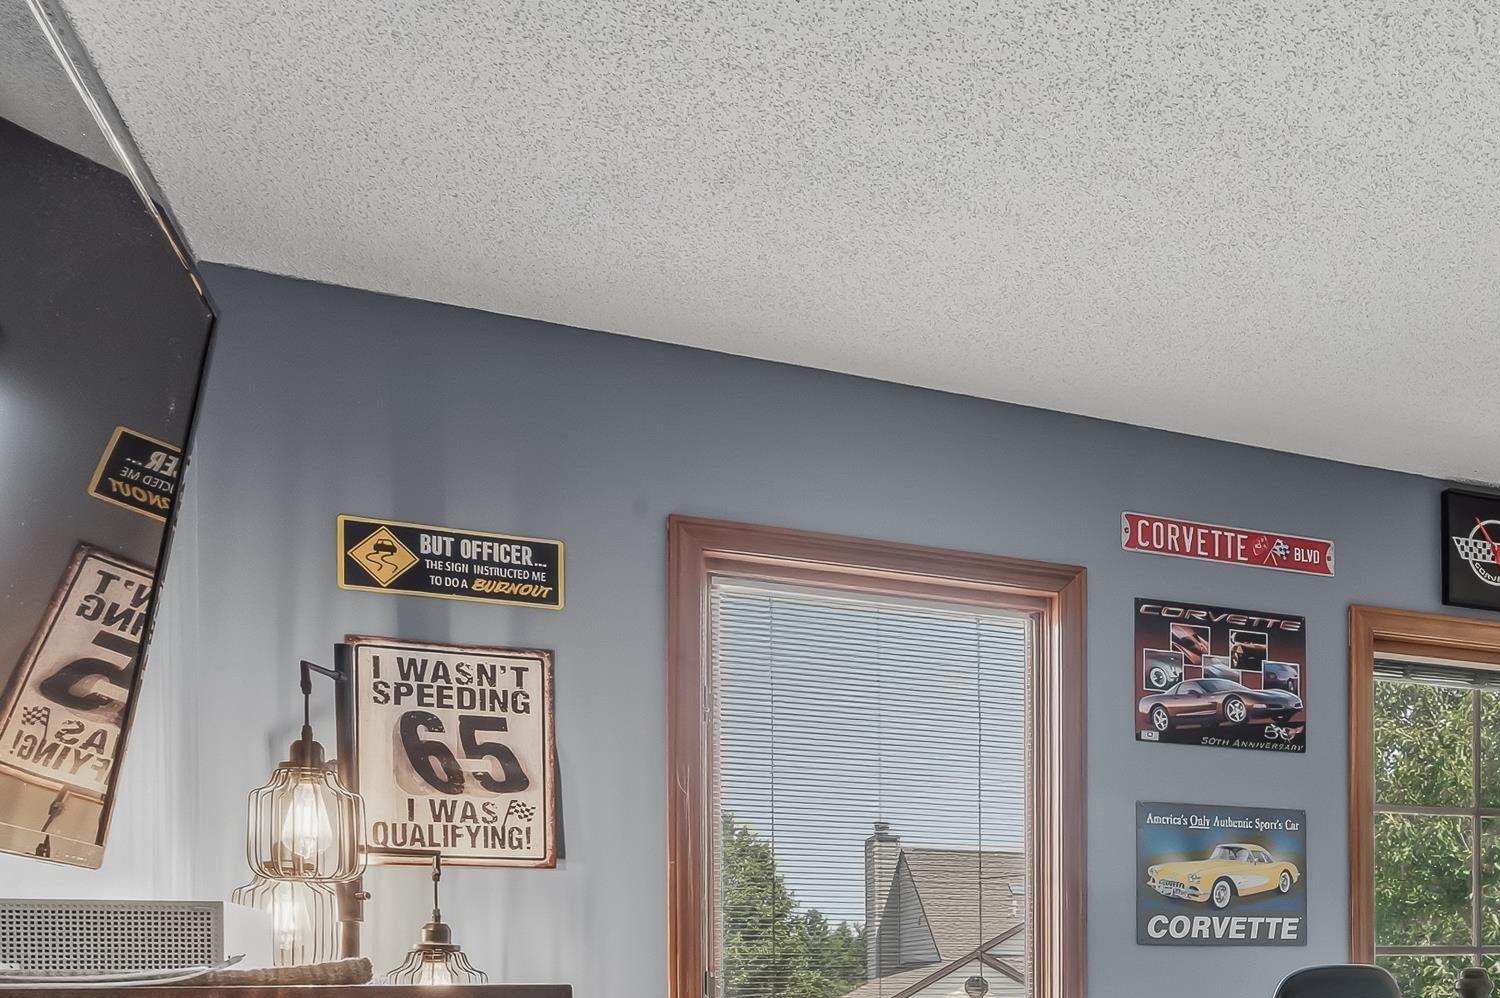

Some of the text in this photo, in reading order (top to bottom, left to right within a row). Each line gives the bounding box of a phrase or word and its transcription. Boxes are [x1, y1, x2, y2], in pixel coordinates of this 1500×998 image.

[419, 533, 548, 568] BUT OFFICER...
[1137, 519, 1320, 564] CORVETTE BLVD
[424, 559, 547, 582] THE SIGN INSTRUCTED ME
[429, 575, 553, 599] TO DO A BURNOUT
[1139, 604, 1303, 632] CORVETTE
[372, 655, 529, 690] I WASN'T
[372, 680, 531, 714] SPEEDING
[399, 710, 530, 795] 65
[1201, 736, 1230, 747] 50TH
[407, 798, 498, 825] I WAS
[1285, 819, 1300, 831] Car
[372, 821, 532, 850] QUALIFYING!
[1147, 914, 1300, 939] CORVETTE
